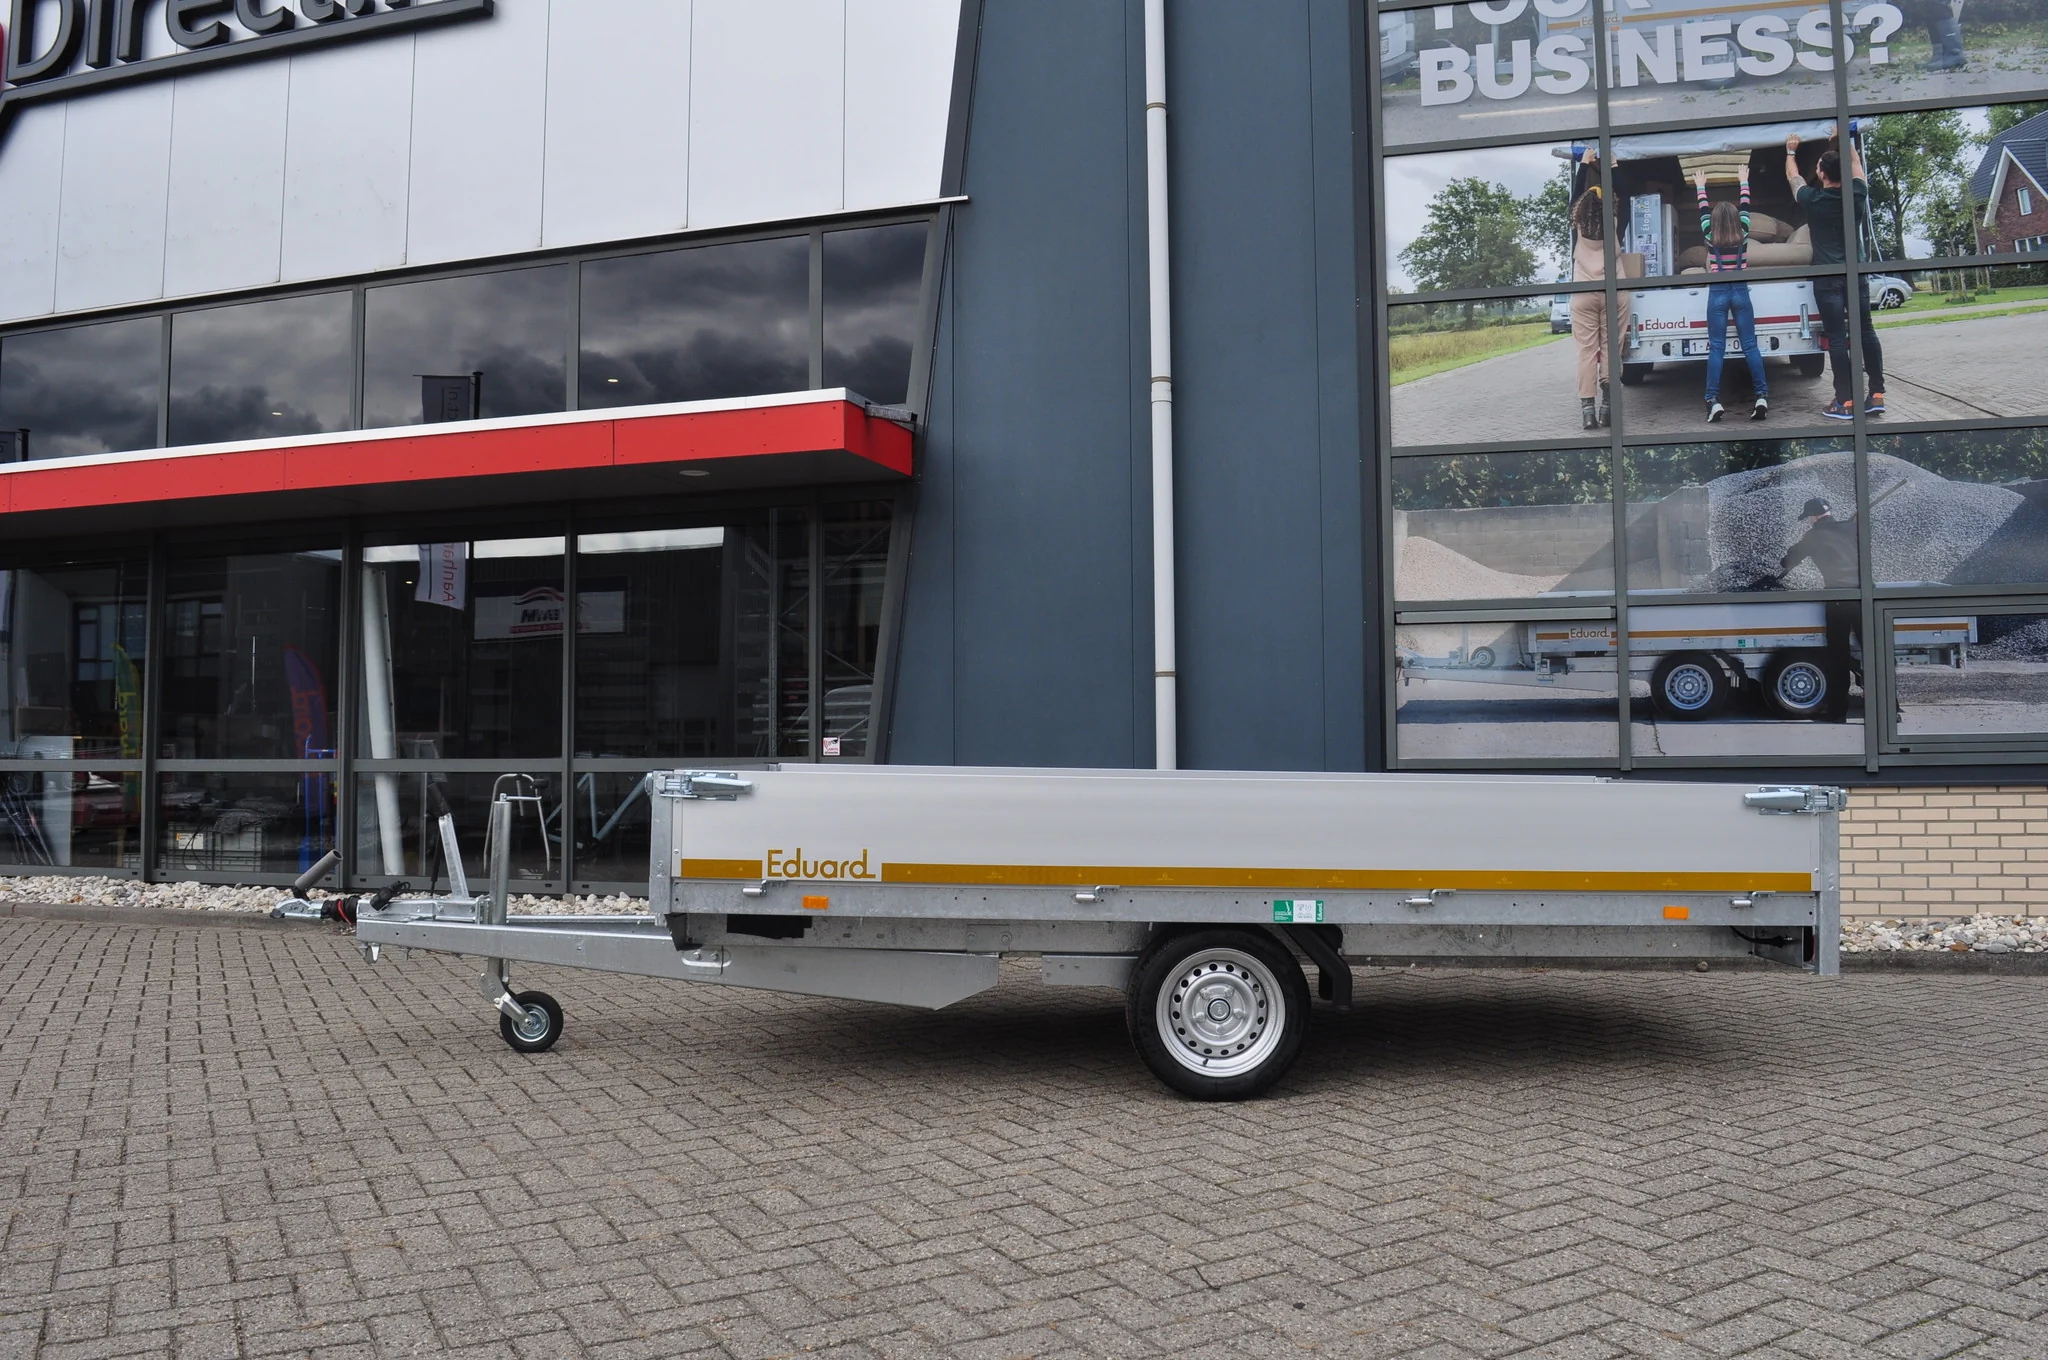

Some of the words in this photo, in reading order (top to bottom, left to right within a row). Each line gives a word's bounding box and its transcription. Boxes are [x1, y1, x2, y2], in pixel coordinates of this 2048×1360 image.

[1645, 316, 1689, 331] Eduard
[1570, 626, 1610, 639] Eduard
[767, 847, 876, 879] Eduard
